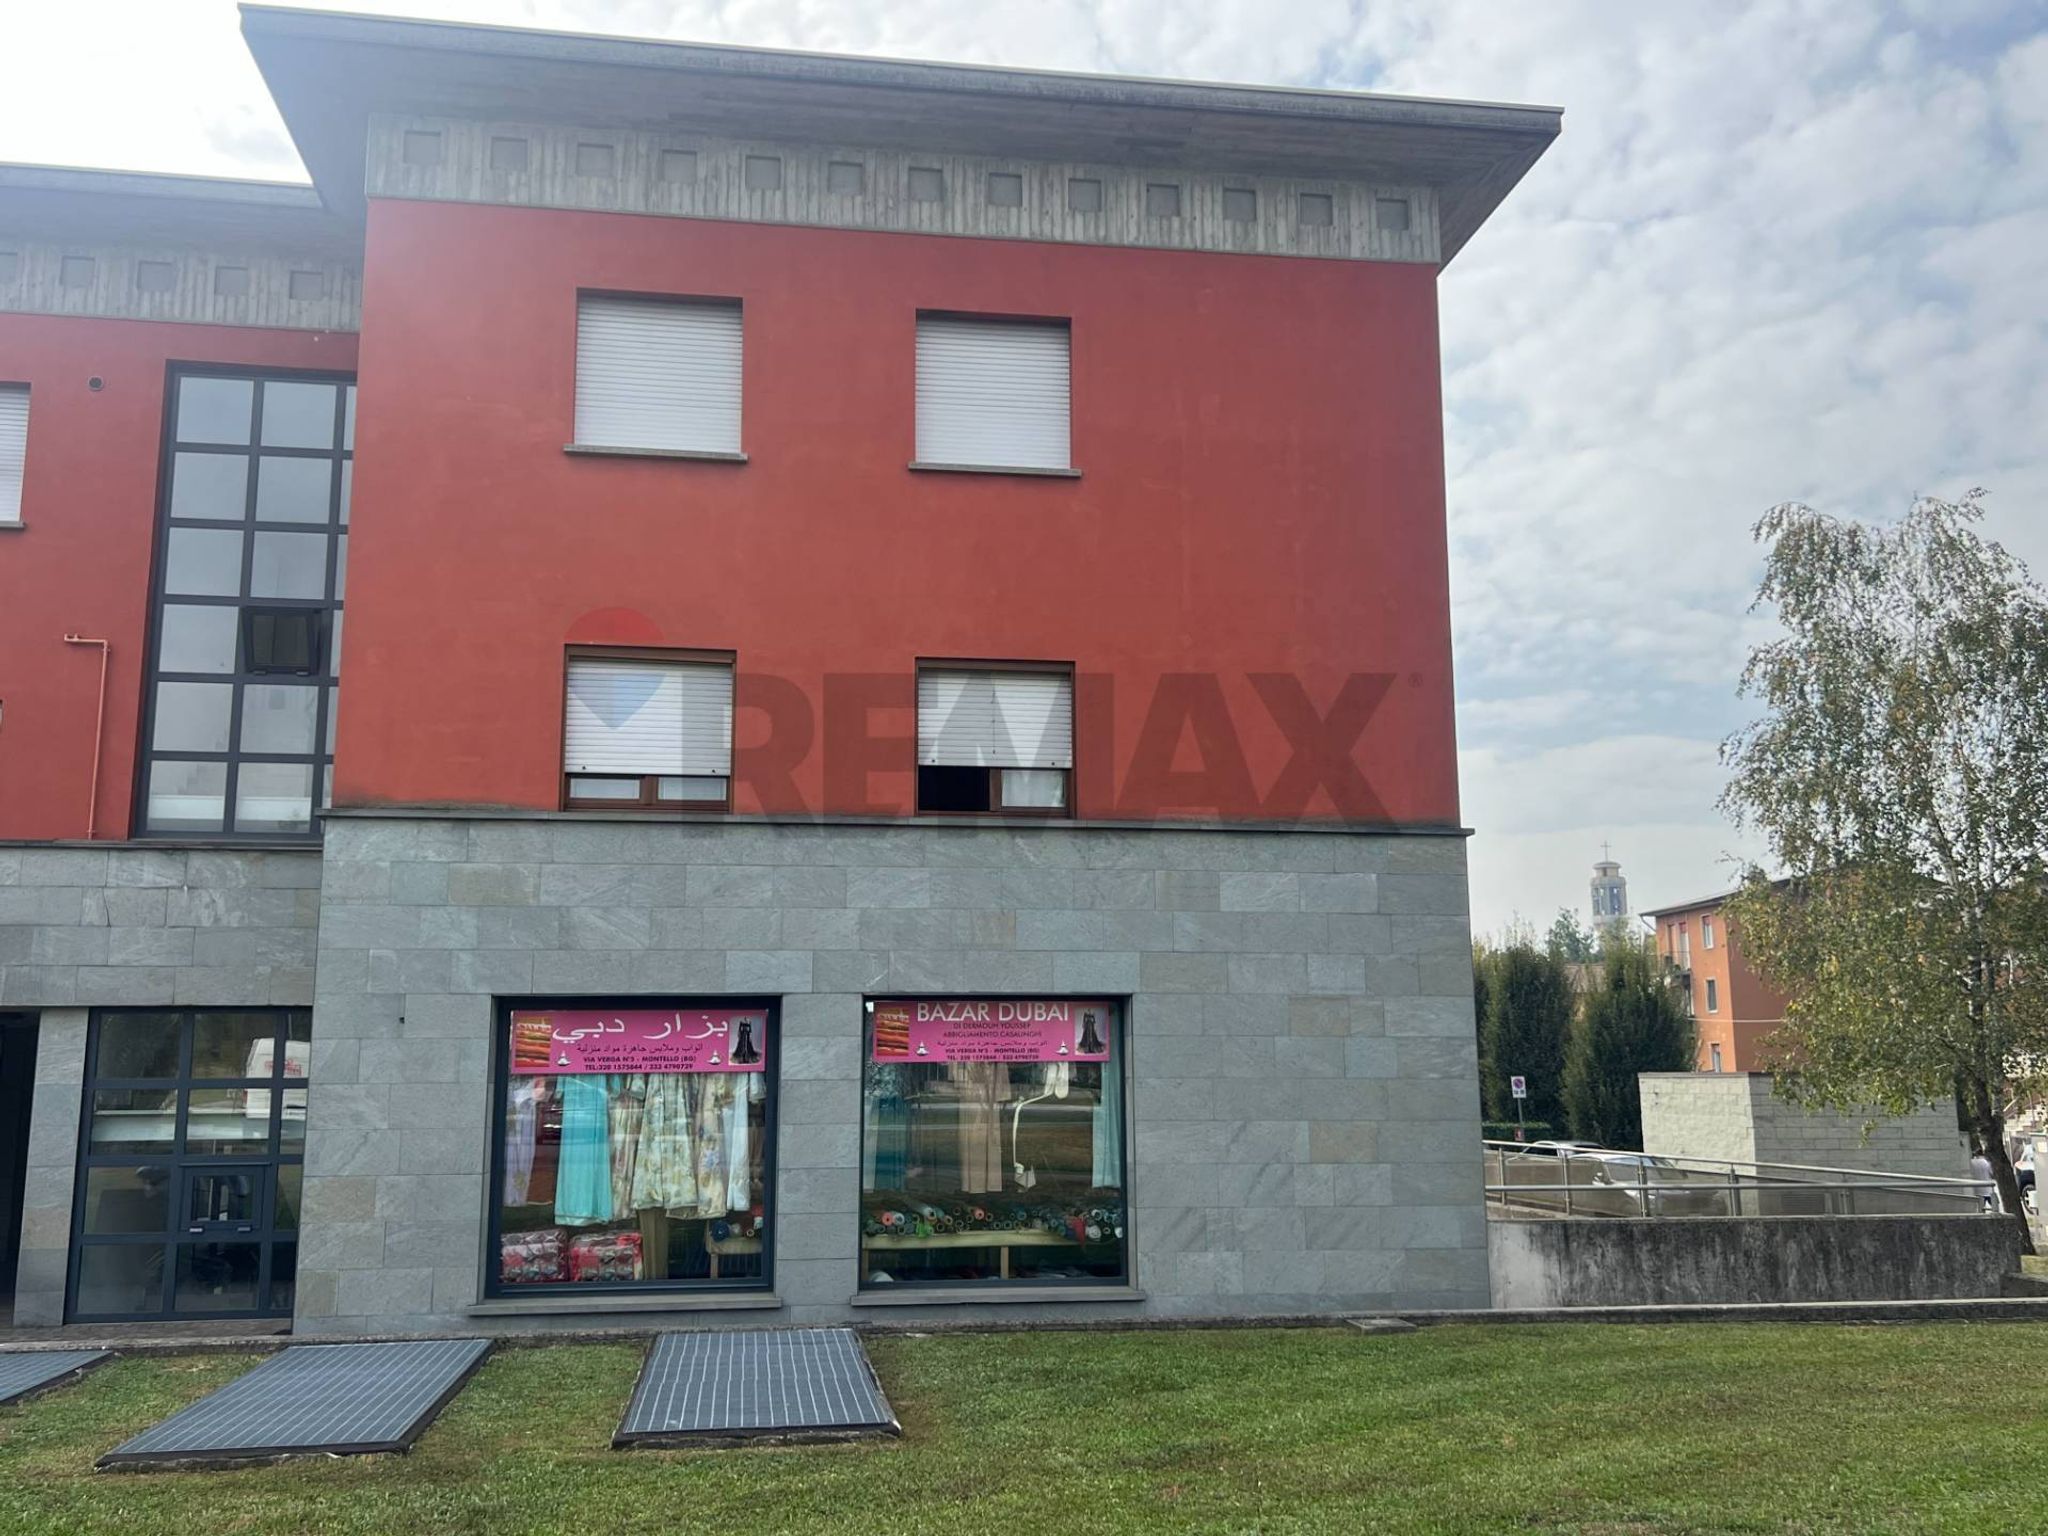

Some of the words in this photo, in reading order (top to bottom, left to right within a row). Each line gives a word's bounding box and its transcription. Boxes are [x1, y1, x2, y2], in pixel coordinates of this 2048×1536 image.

[917, 1002, 990, 1021] BAZAR
[999, 1002, 1068, 1021] DUBAI
[553, 1018, 625, 1043] دبي
[681, 1055, 697, 1063] (BG)
